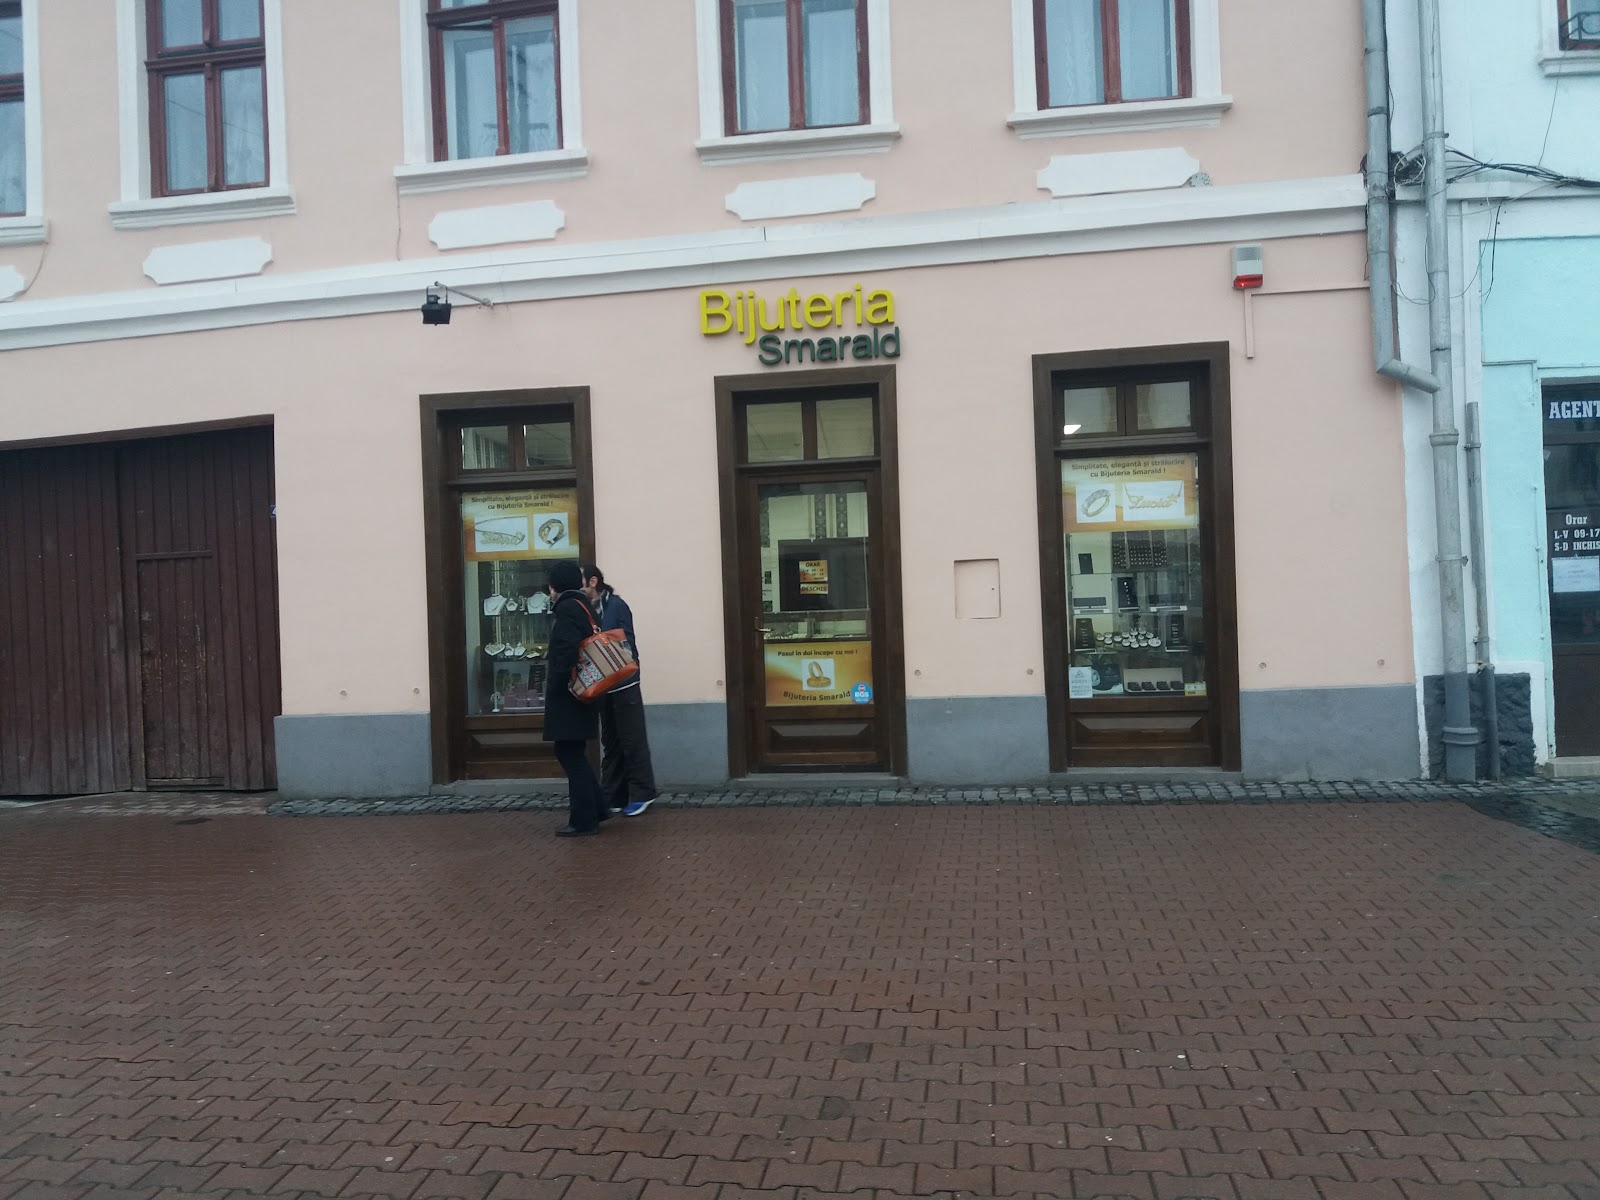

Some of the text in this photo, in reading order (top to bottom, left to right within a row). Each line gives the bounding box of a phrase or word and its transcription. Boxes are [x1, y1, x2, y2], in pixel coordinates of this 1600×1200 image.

[699, 281, 895, 345] Bijuteria
[758, 326, 900, 365] Smarald
[1100, 470, 1131, 478] Bijuteria
[1565, 514, 1588, 525] Orar
[1554, 530, 1569, 539] L-V
[1554, 541, 1569, 551] S-D
[783, 690, 851, 701] Bijuteria Smarald
